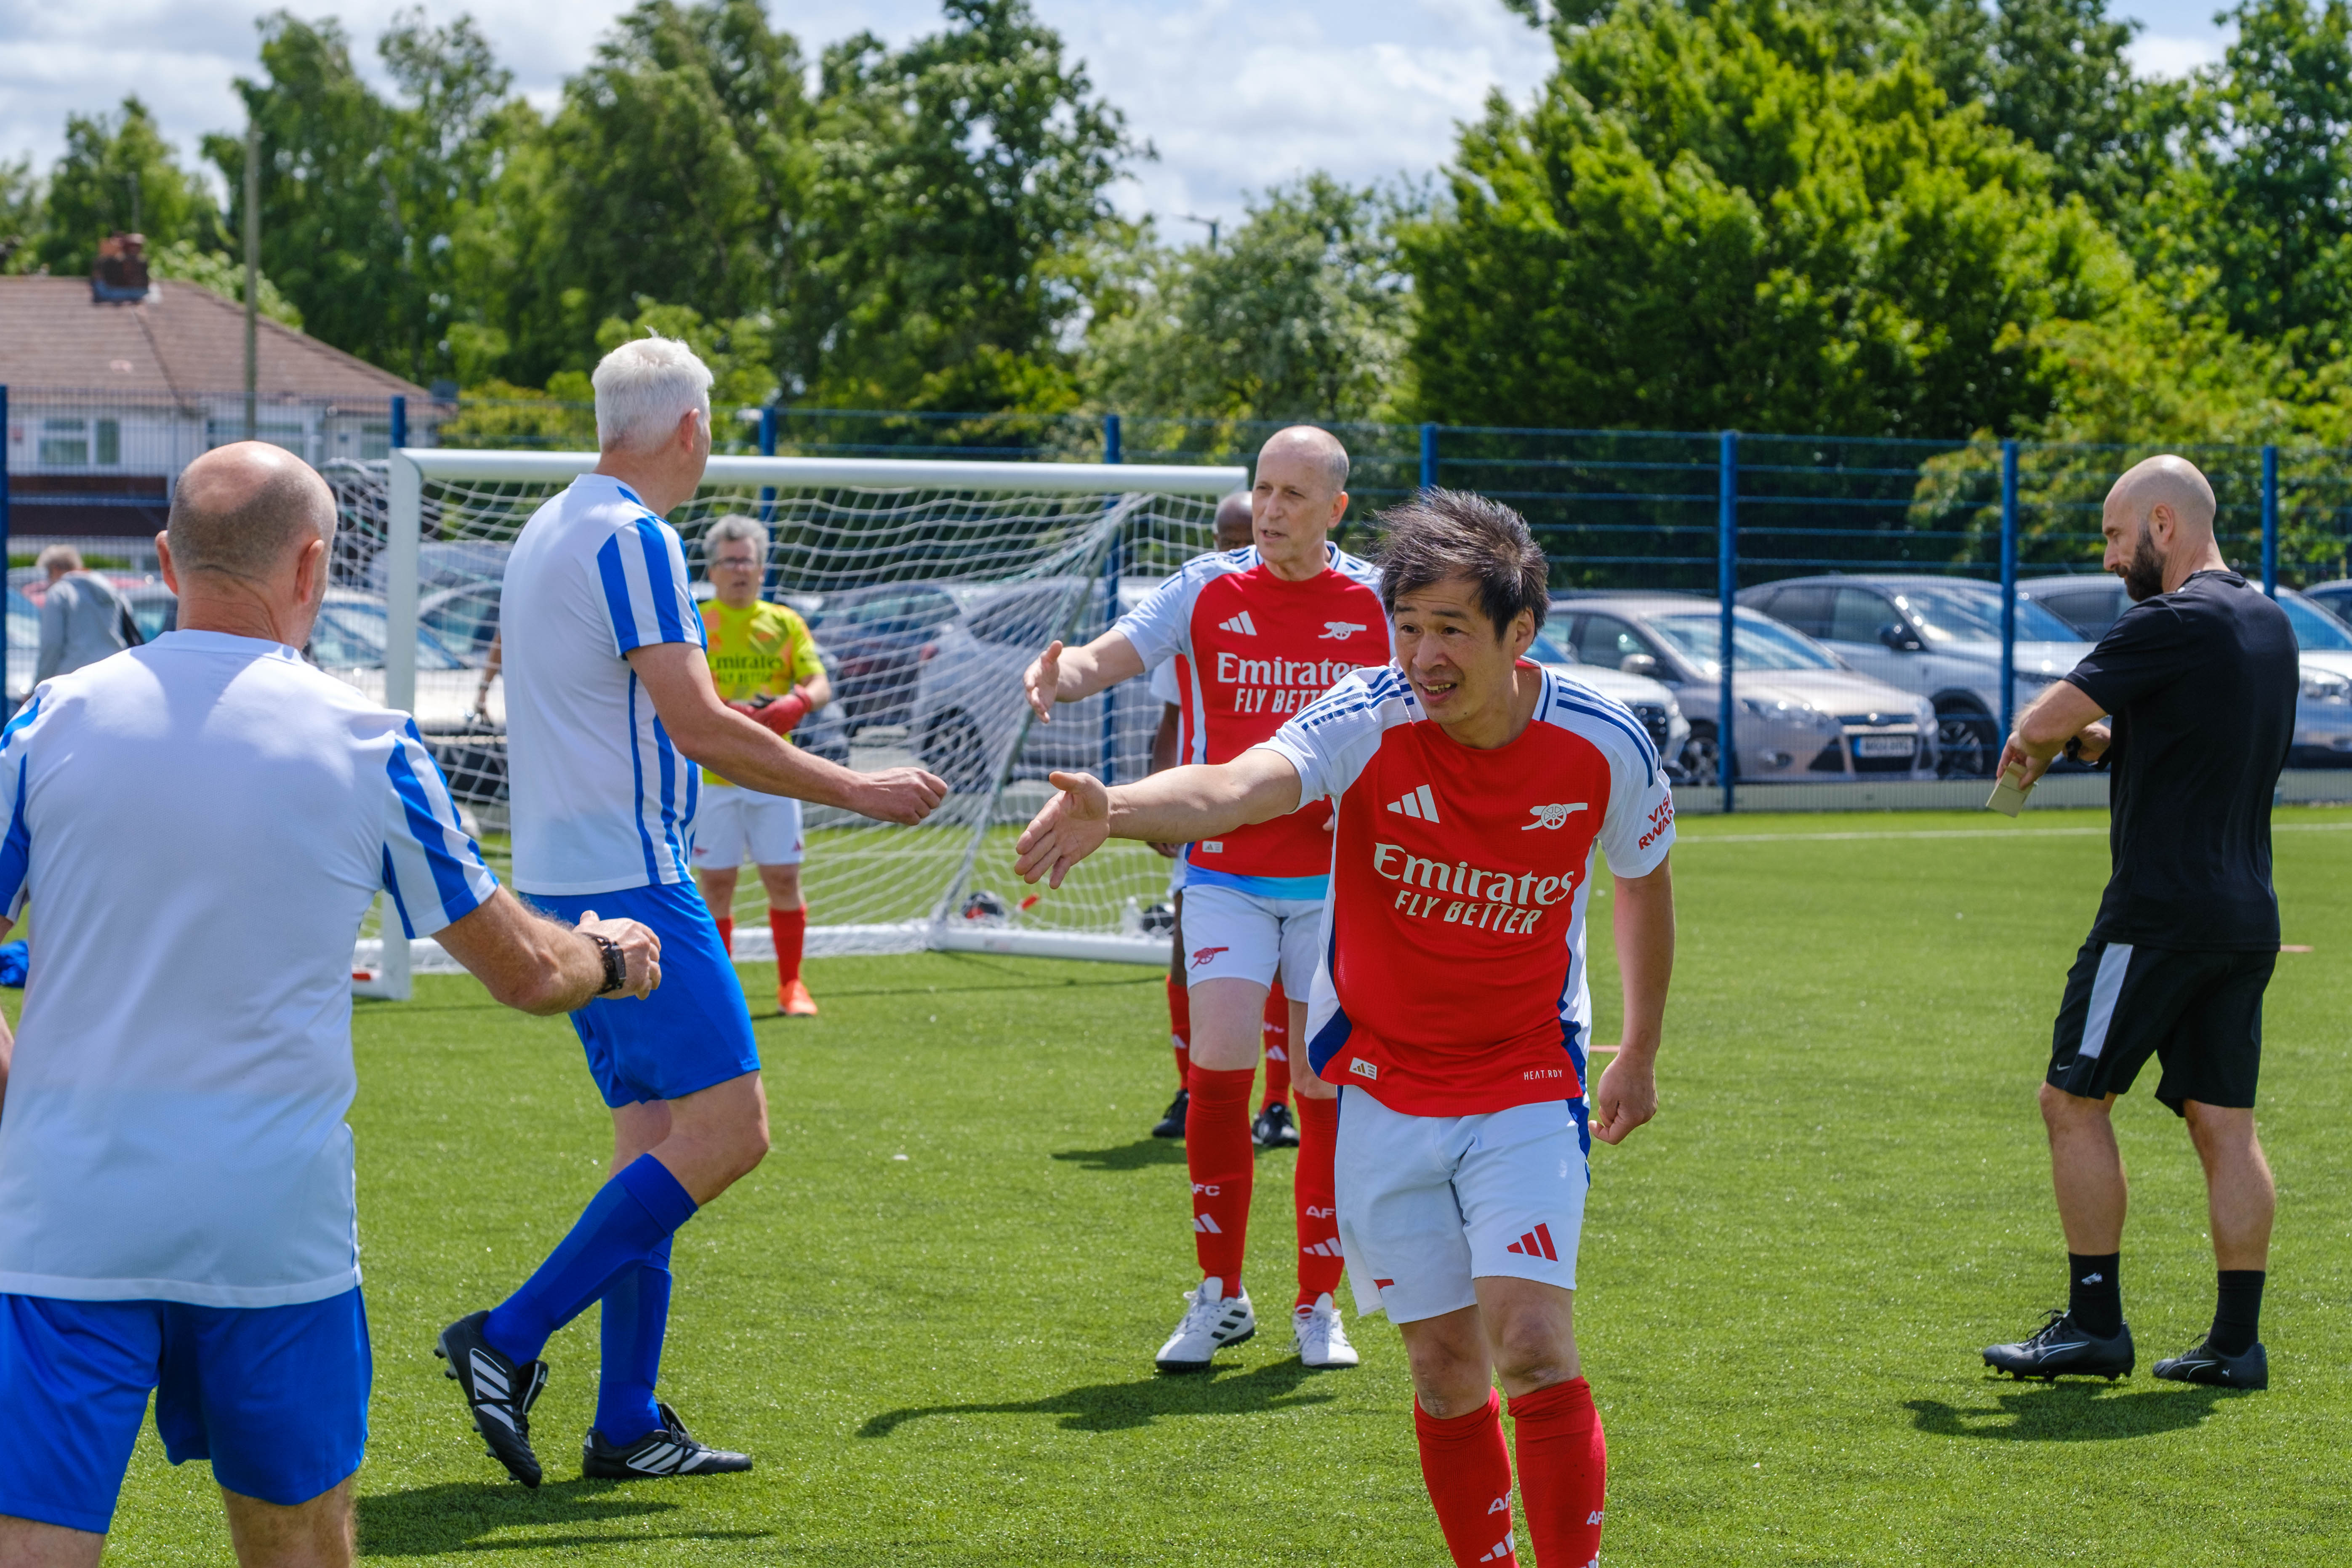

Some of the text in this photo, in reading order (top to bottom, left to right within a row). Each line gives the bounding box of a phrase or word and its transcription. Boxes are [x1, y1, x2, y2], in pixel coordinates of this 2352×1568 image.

[1235, 688, 1329, 713] FLY BETT
[1374, 842, 1574, 905] Emirates
[1394, 890, 1542, 934] FLY BETTER
[1524, 1069, 1562, 1081] HEAT.RDY
